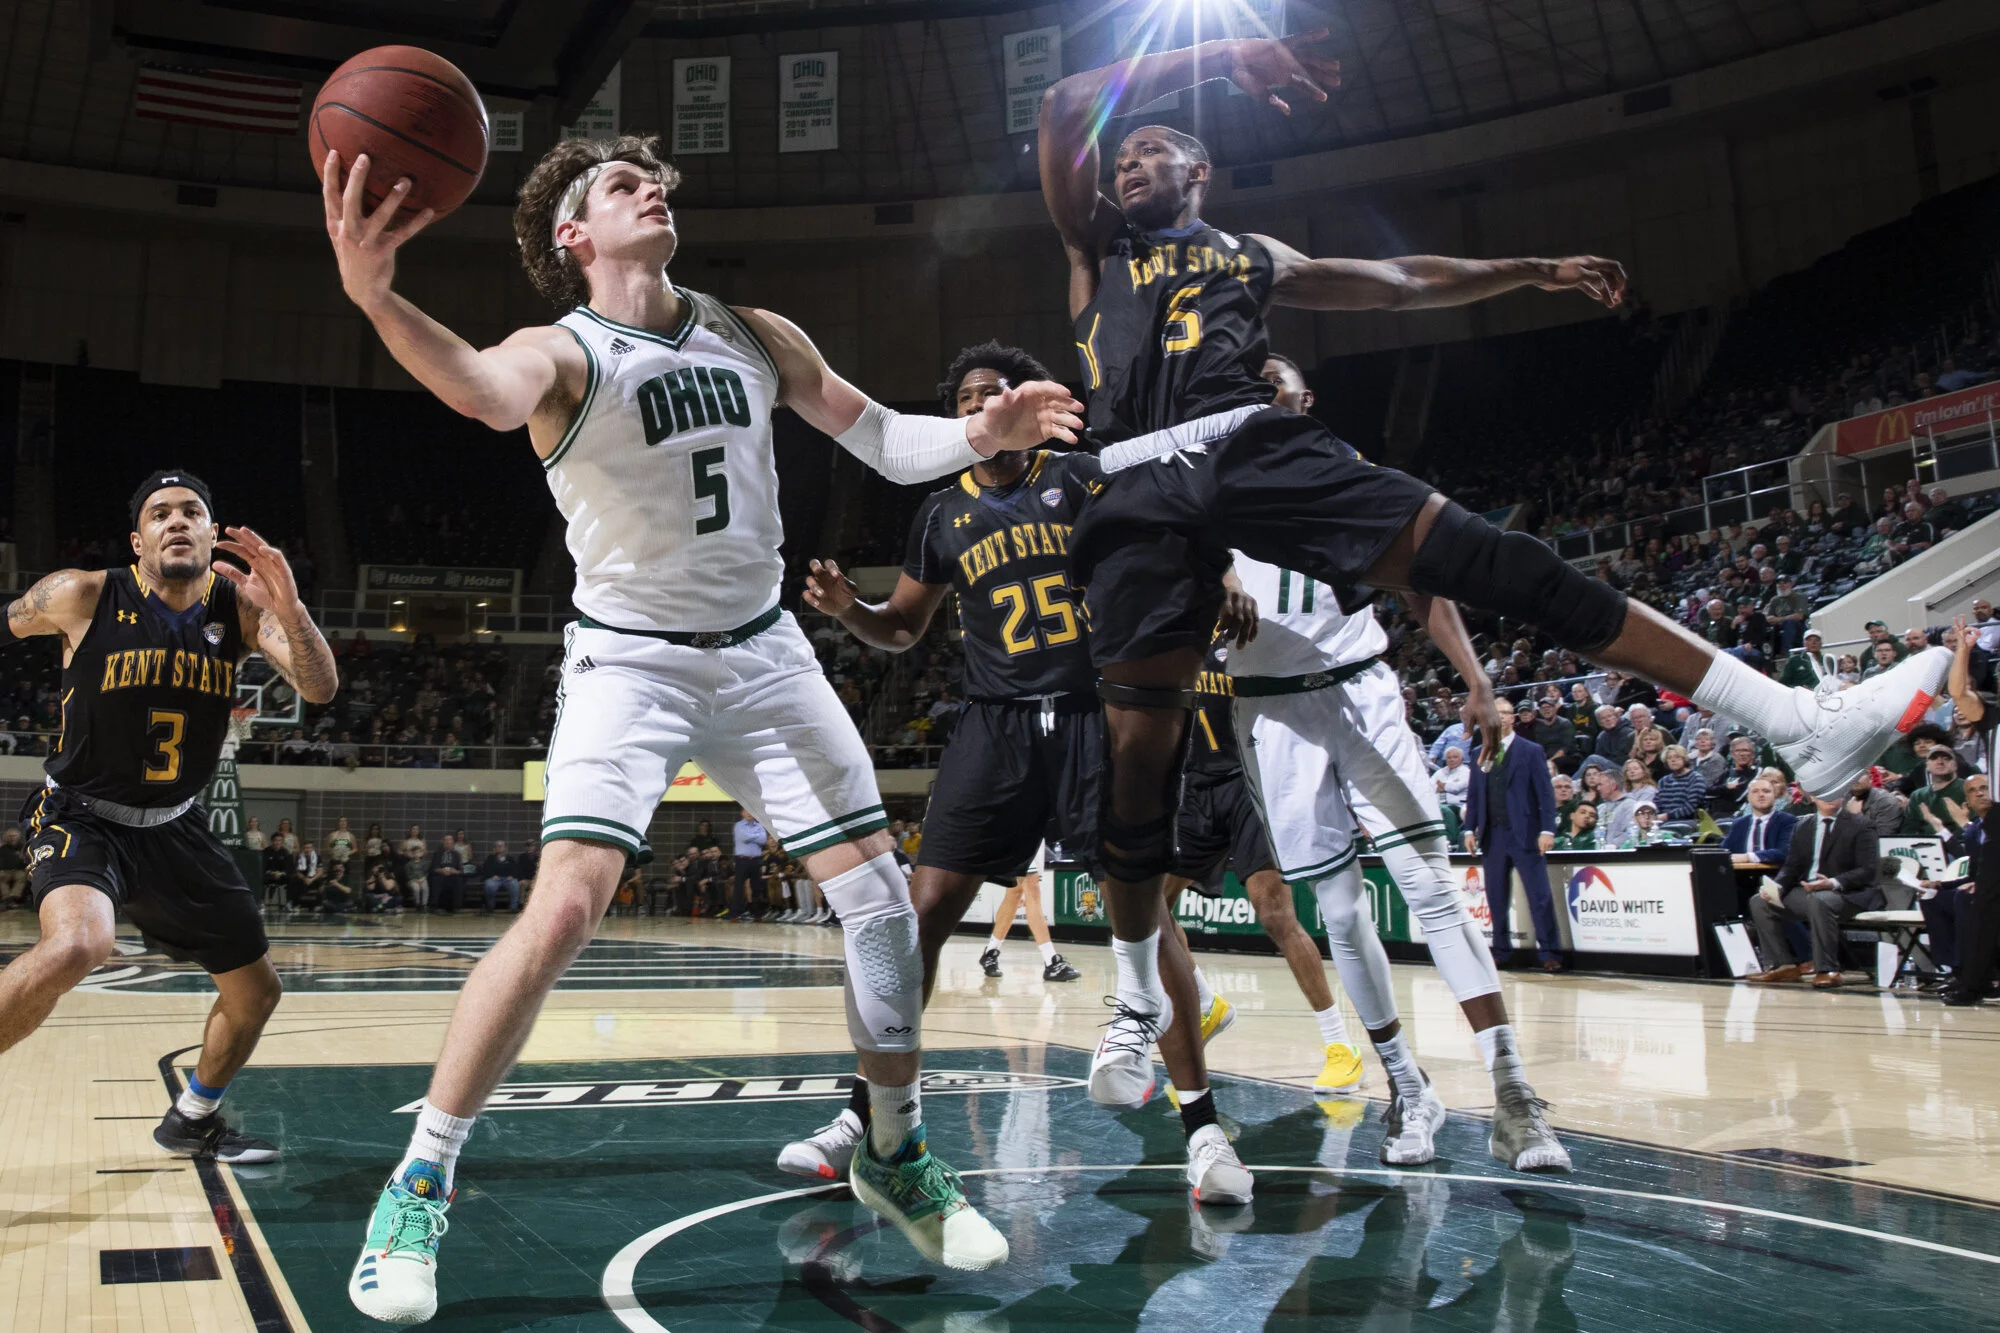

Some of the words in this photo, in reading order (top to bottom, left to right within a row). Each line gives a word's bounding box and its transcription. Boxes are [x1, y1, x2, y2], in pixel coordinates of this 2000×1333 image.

[1017, 36, 1048, 57] OHIO
[686, 64, 717, 82] OHIO
[793, 60, 825, 79] OHIO
[1127, 244, 1178, 295] KENT
[1186, 244, 1251, 283] STATE
[637, 366, 751, 446] OHIO
[689, 442, 731, 537] 5
[959, 529, 1010, 587] KENT
[388, 573, 437, 585] Holzer
[463, 575, 512, 587] Holzer
[989, 570, 1080, 658] 25
[101, 650, 167, 693] KENT
[141, 707, 188, 784] 3
[1581, 900, 1618, 913] DAVID
[1622, 900, 1664, 914] WHITE
[1581, 917, 1622, 929] SERVICES,
